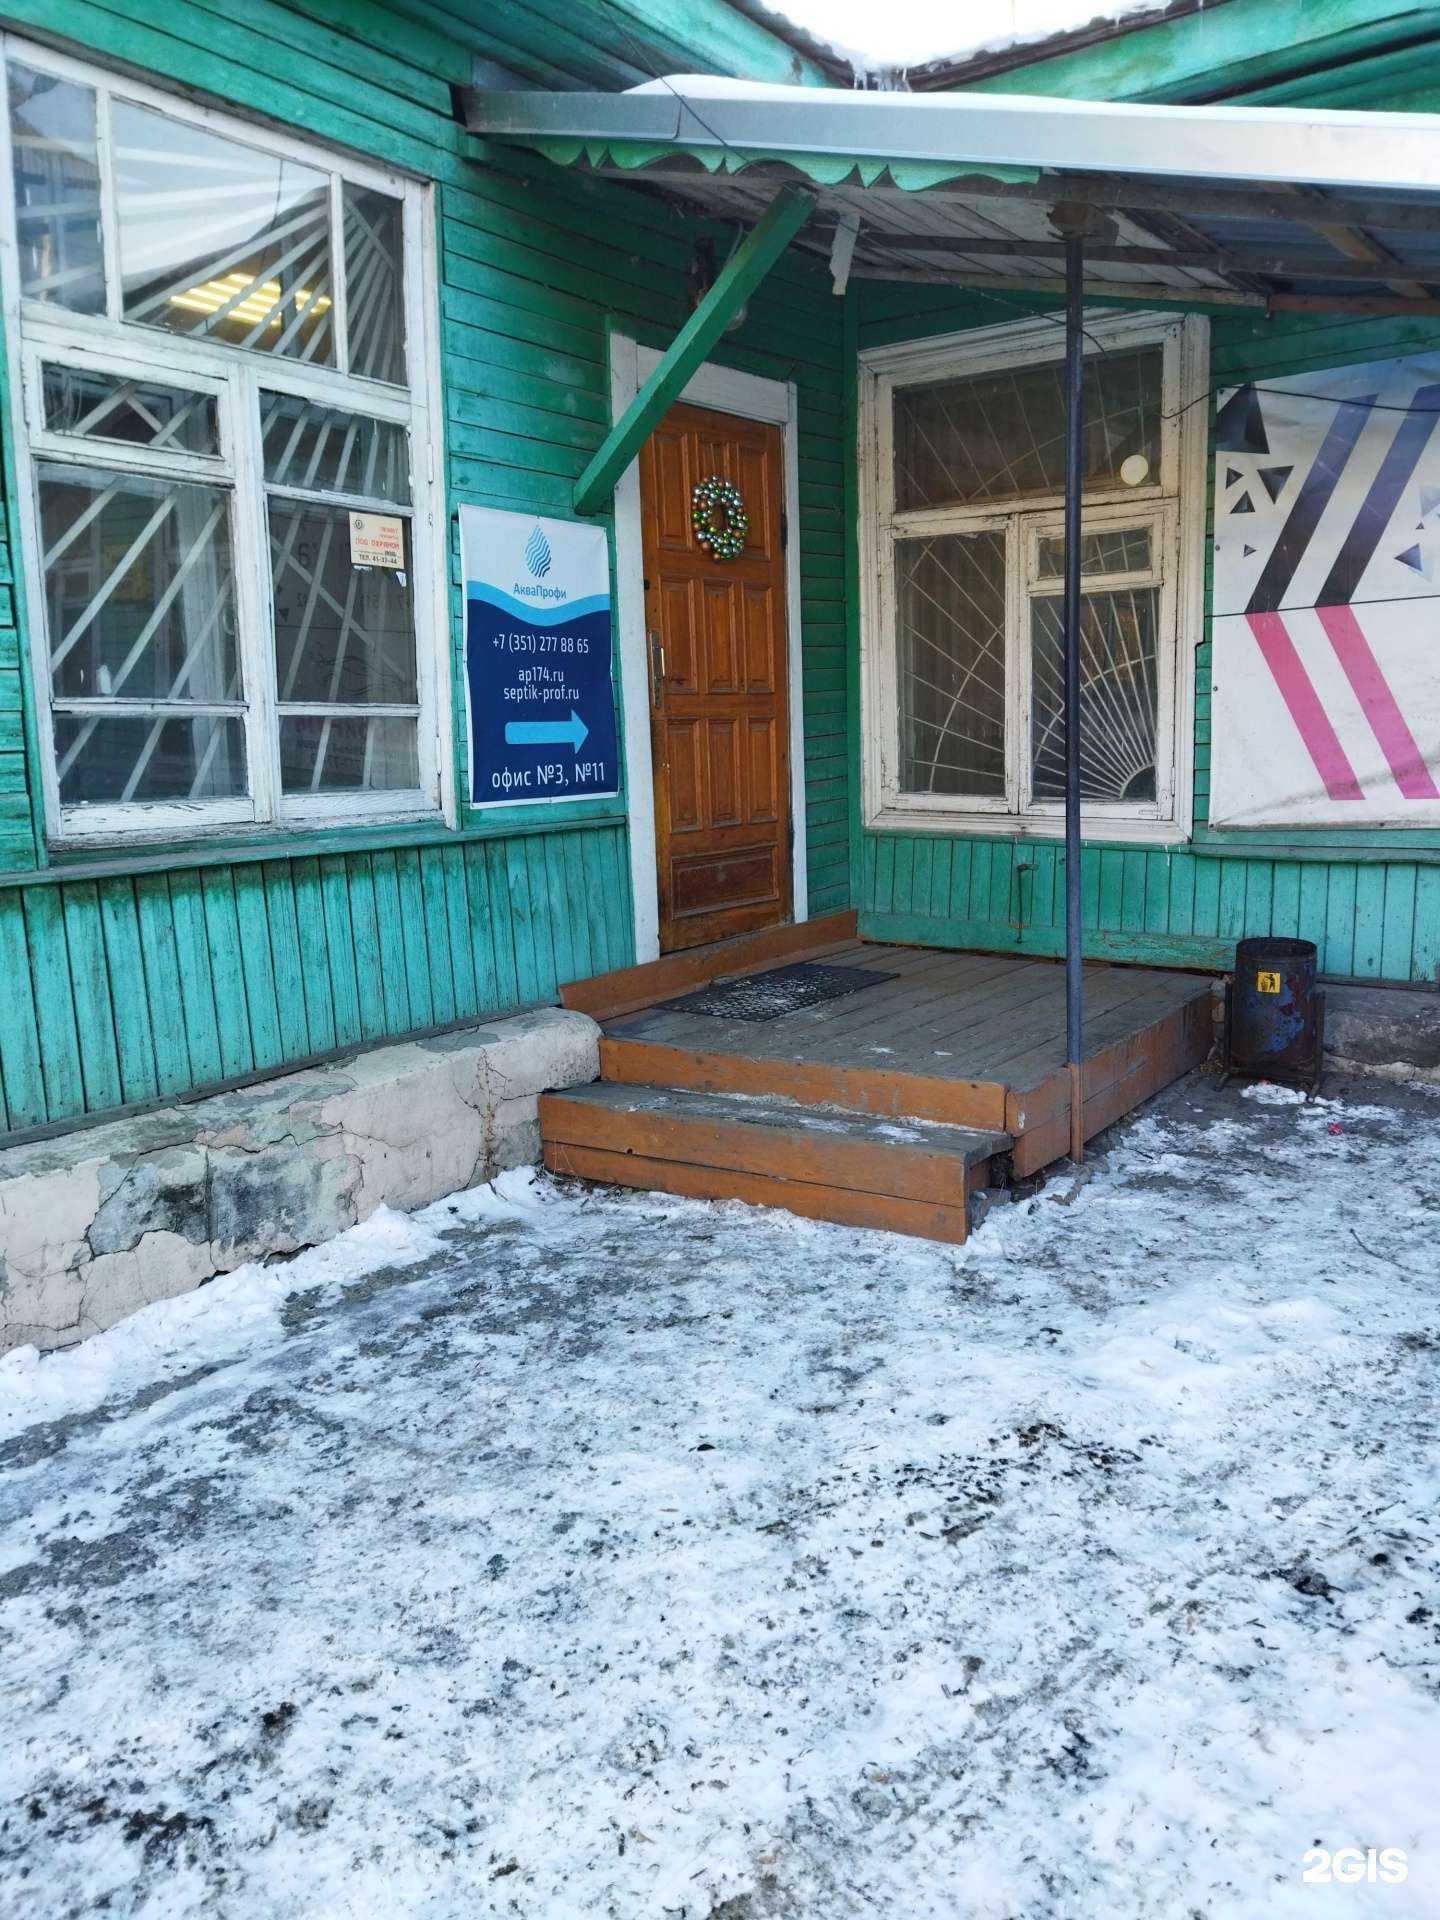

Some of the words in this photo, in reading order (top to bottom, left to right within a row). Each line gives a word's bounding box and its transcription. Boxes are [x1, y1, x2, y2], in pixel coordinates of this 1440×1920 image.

[513, 582, 567, 600] АкваПрофи
[493, 634, 505, 650] +7
[508, 633, 536, 654] (351)
[540, 636, 558, 652] 277
[561, 637, 574, 653] 88
[577, 638, 589, 653] 65
[518, 667, 564, 684] ap174.ru
[504, 685, 580, 703] septik-prof.ru
[492, 767, 532, 792] офис
[537, 764, 569, 786] №3,
[575, 762, 605, 783] №11
